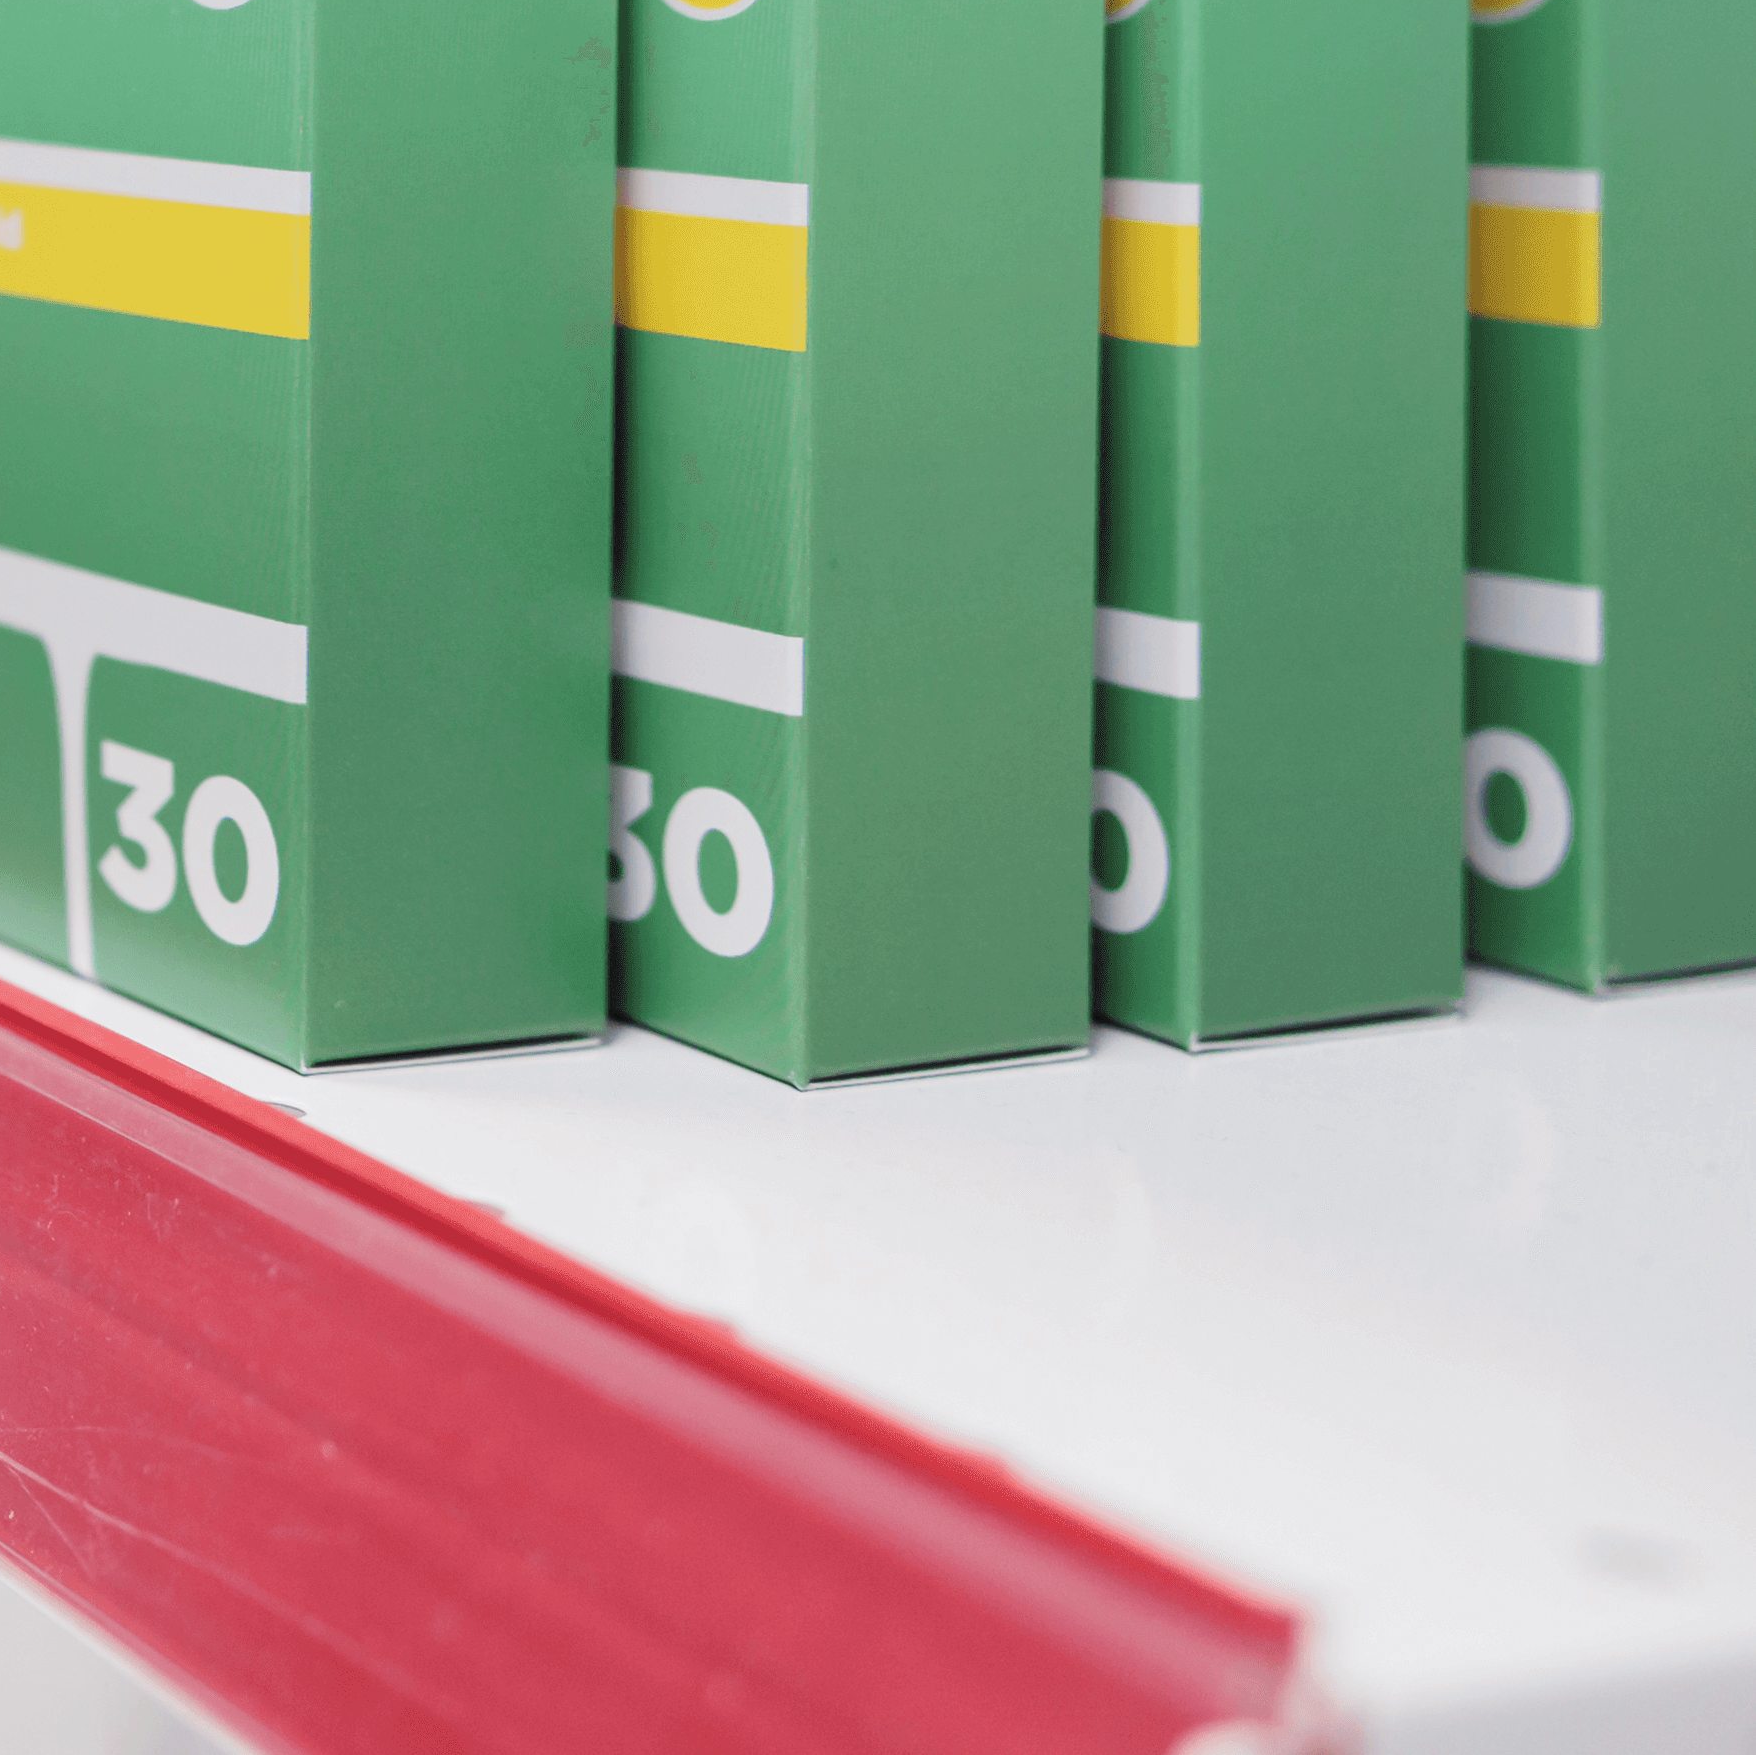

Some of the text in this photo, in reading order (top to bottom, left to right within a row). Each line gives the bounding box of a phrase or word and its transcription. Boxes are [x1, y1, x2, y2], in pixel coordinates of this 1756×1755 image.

[98, 738, 280, 947] 30
[1089, 768, 1171, 934] 0
[1462, 727, 1574, 890] 0
